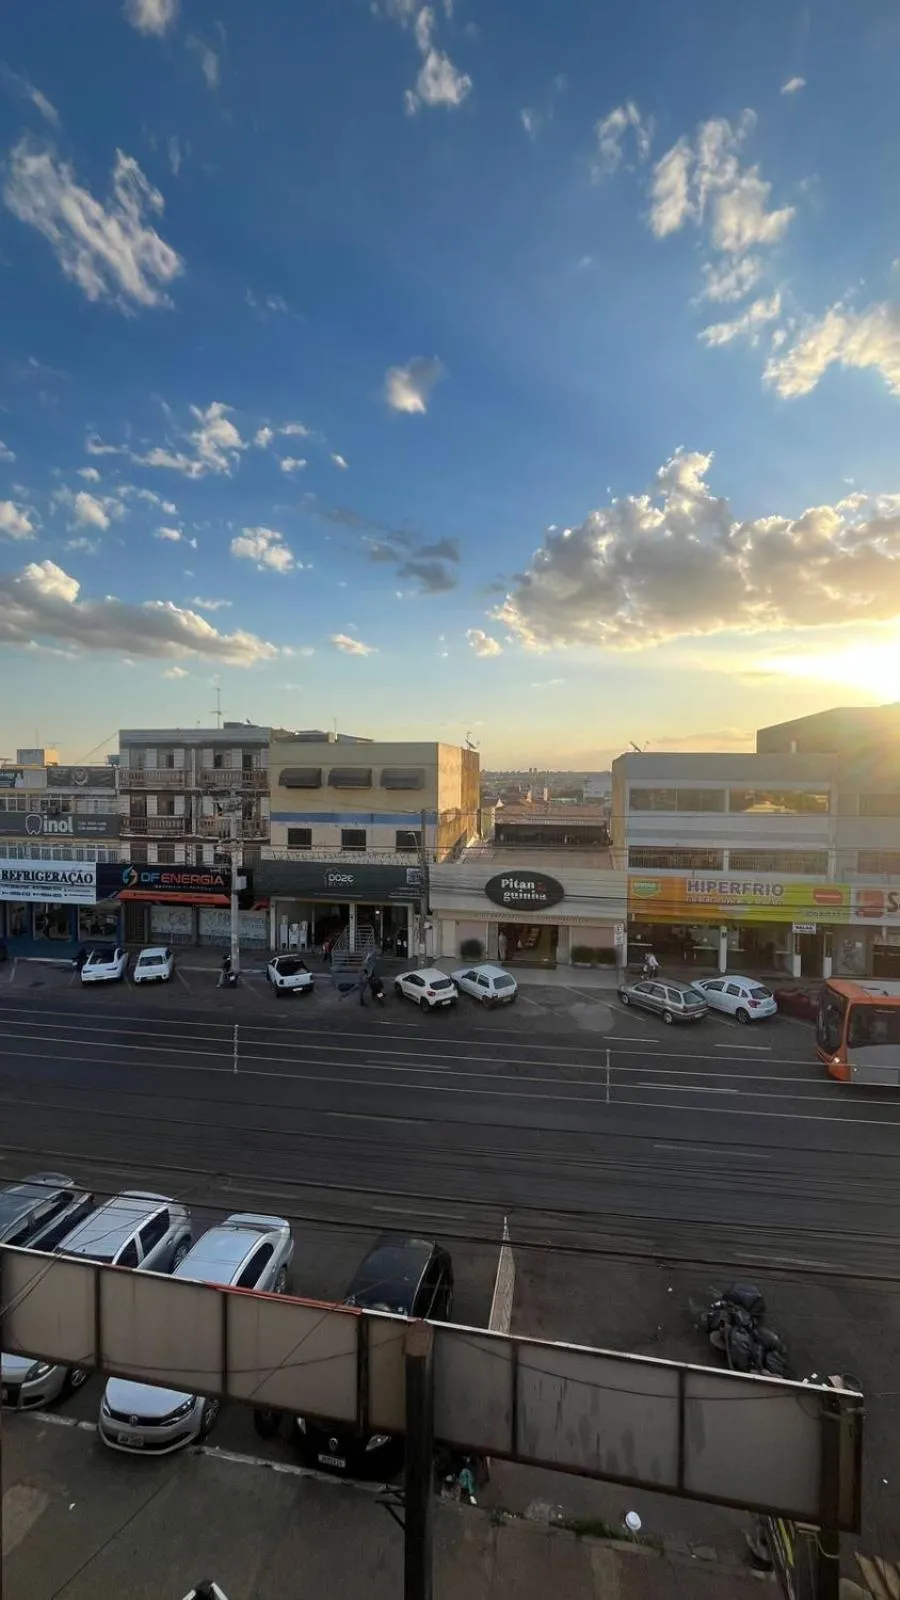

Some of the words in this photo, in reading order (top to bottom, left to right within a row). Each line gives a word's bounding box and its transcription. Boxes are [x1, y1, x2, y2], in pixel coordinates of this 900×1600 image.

[1, 869, 94, 886] REFRIGERAÇÃO
[160, 872, 226, 886] ENERGIA
[501, 878, 536, 889] Pitan
[687, 879, 785, 897] HIPERFRIO
